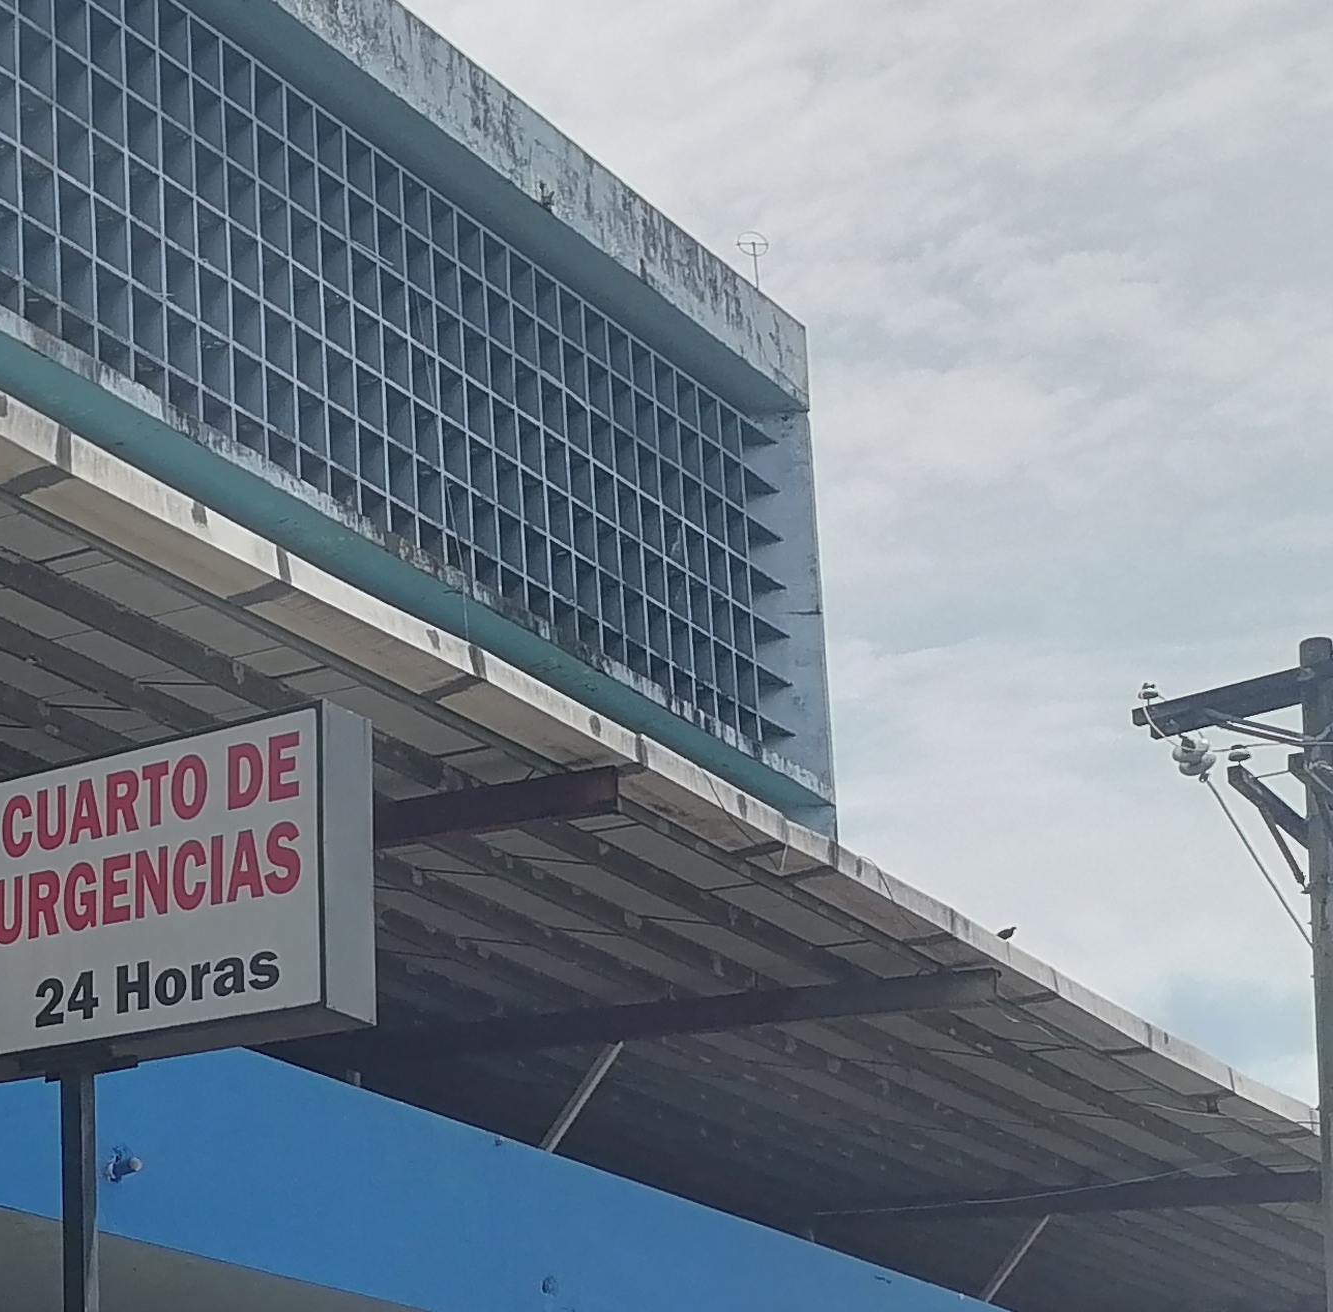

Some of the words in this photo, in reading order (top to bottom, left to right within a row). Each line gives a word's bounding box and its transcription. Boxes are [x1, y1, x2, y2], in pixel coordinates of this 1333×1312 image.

[2, 754, 208, 859] CUARTO
[227, 731, 301, 811] DE
[34, 970, 99, 1029] 24
[116, 950, 281, 1015] Horas
